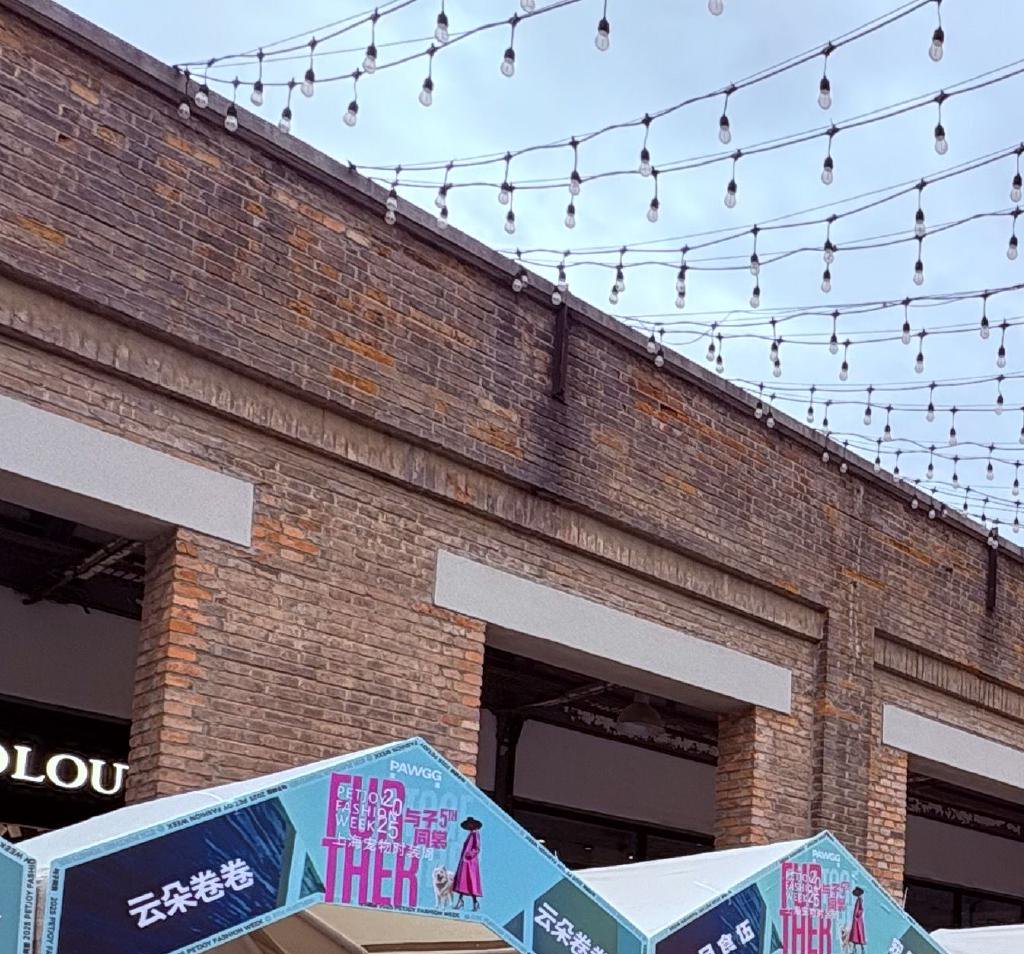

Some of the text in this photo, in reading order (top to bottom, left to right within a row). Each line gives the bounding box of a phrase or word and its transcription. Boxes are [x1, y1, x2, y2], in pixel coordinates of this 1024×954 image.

[0, 744, 129, 795] LOU
[389, 760, 442, 783] PAWGG
[335, 814, 399, 839] WEEK 25
[22, 890, 34, 919] PETJOY
[127, 858, 255, 928] 云朵卷卷
